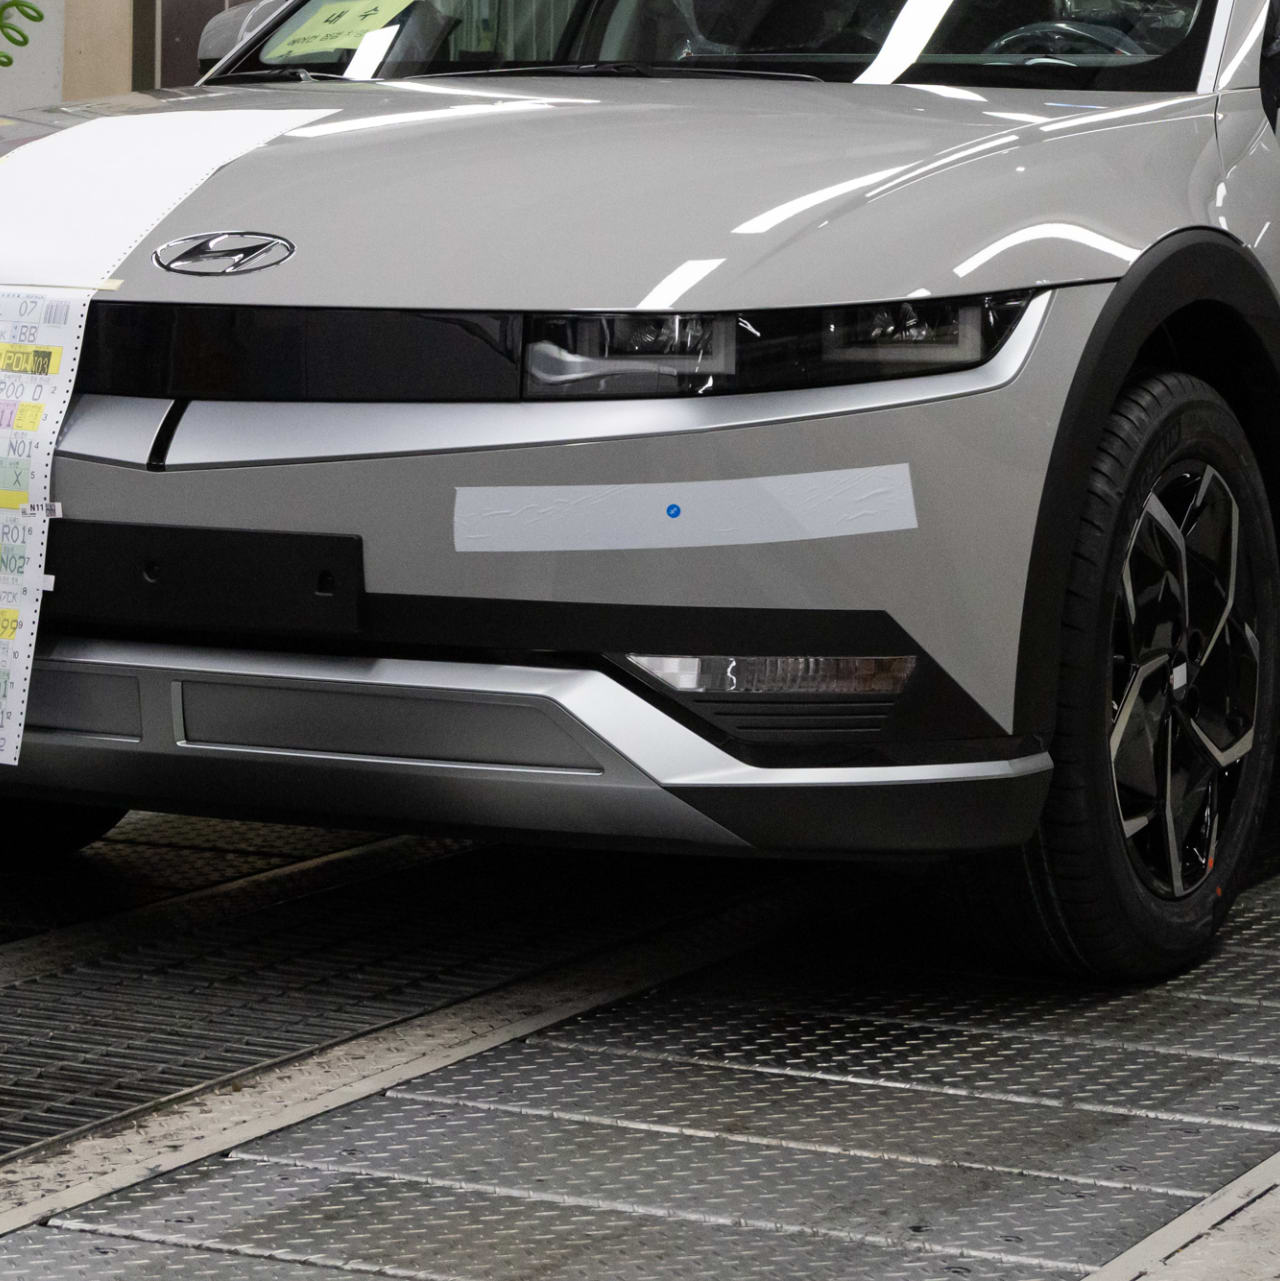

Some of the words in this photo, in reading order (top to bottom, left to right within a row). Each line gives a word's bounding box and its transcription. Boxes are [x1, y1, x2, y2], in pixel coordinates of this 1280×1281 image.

[357, 6, 380, 21] 수
[19, 300, 38, 317] 07
[18, 325, 39, 343] BB
[8, 439, 32, 458] N01
[13, 471, 22, 487] X
[29, 503, 44, 512] N11
[0, 554, 25, 575] N02
